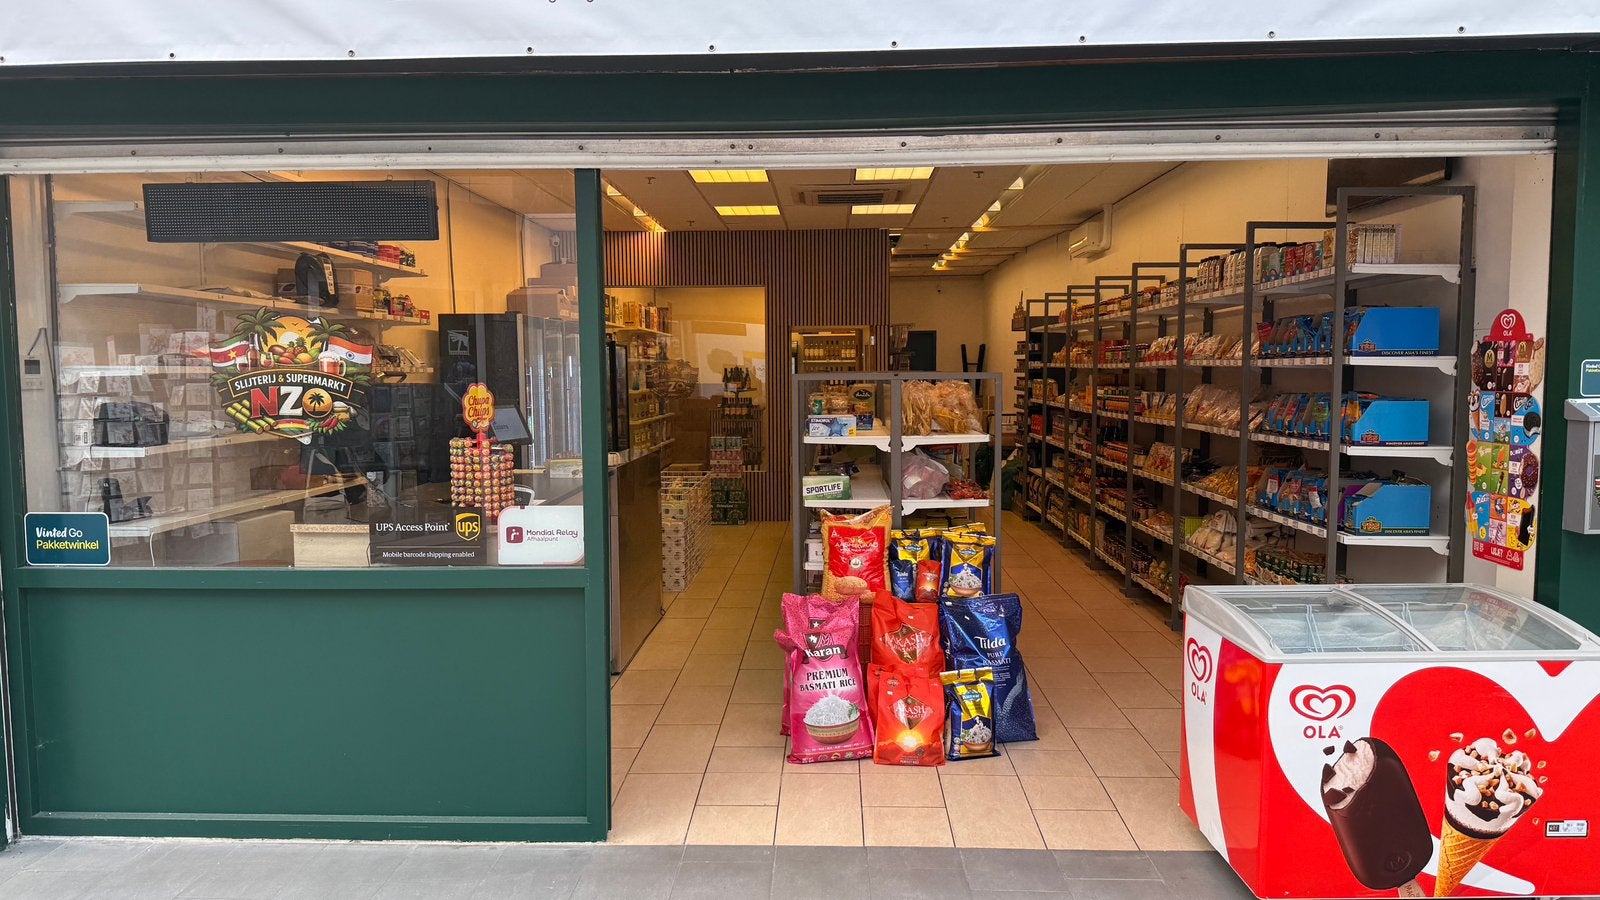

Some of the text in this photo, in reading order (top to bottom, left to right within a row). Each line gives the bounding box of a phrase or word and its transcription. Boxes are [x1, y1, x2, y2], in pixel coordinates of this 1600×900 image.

[234, 373, 346, 392] SLIJTERIJ & SUPERMARKT
[468, 395, 490, 406] Chupa
[467, 406, 490, 418] Chups
[806, 483, 842, 494] SPORTLIFE
[36, 527, 83, 538] Vinted Go
[375, 523, 448, 532] UPS Access Point
[457, 521, 480, 537] ups
[555, 529, 579, 539] Relay
[36, 540, 99, 549] Pakketwinkel
[974, 636, 1007, 649] Tilda
[804, 646, 841, 658] Karan
[986, 650, 1004, 658] PURE
[982, 657, 1011, 666] BASMATI
[806, 667, 849, 681] PREMIUM
[799, 678, 856, 692] BASMATI RICE
[1191, 682, 1207, 705] OLA
[1303, 725, 1341, 739] OLA
